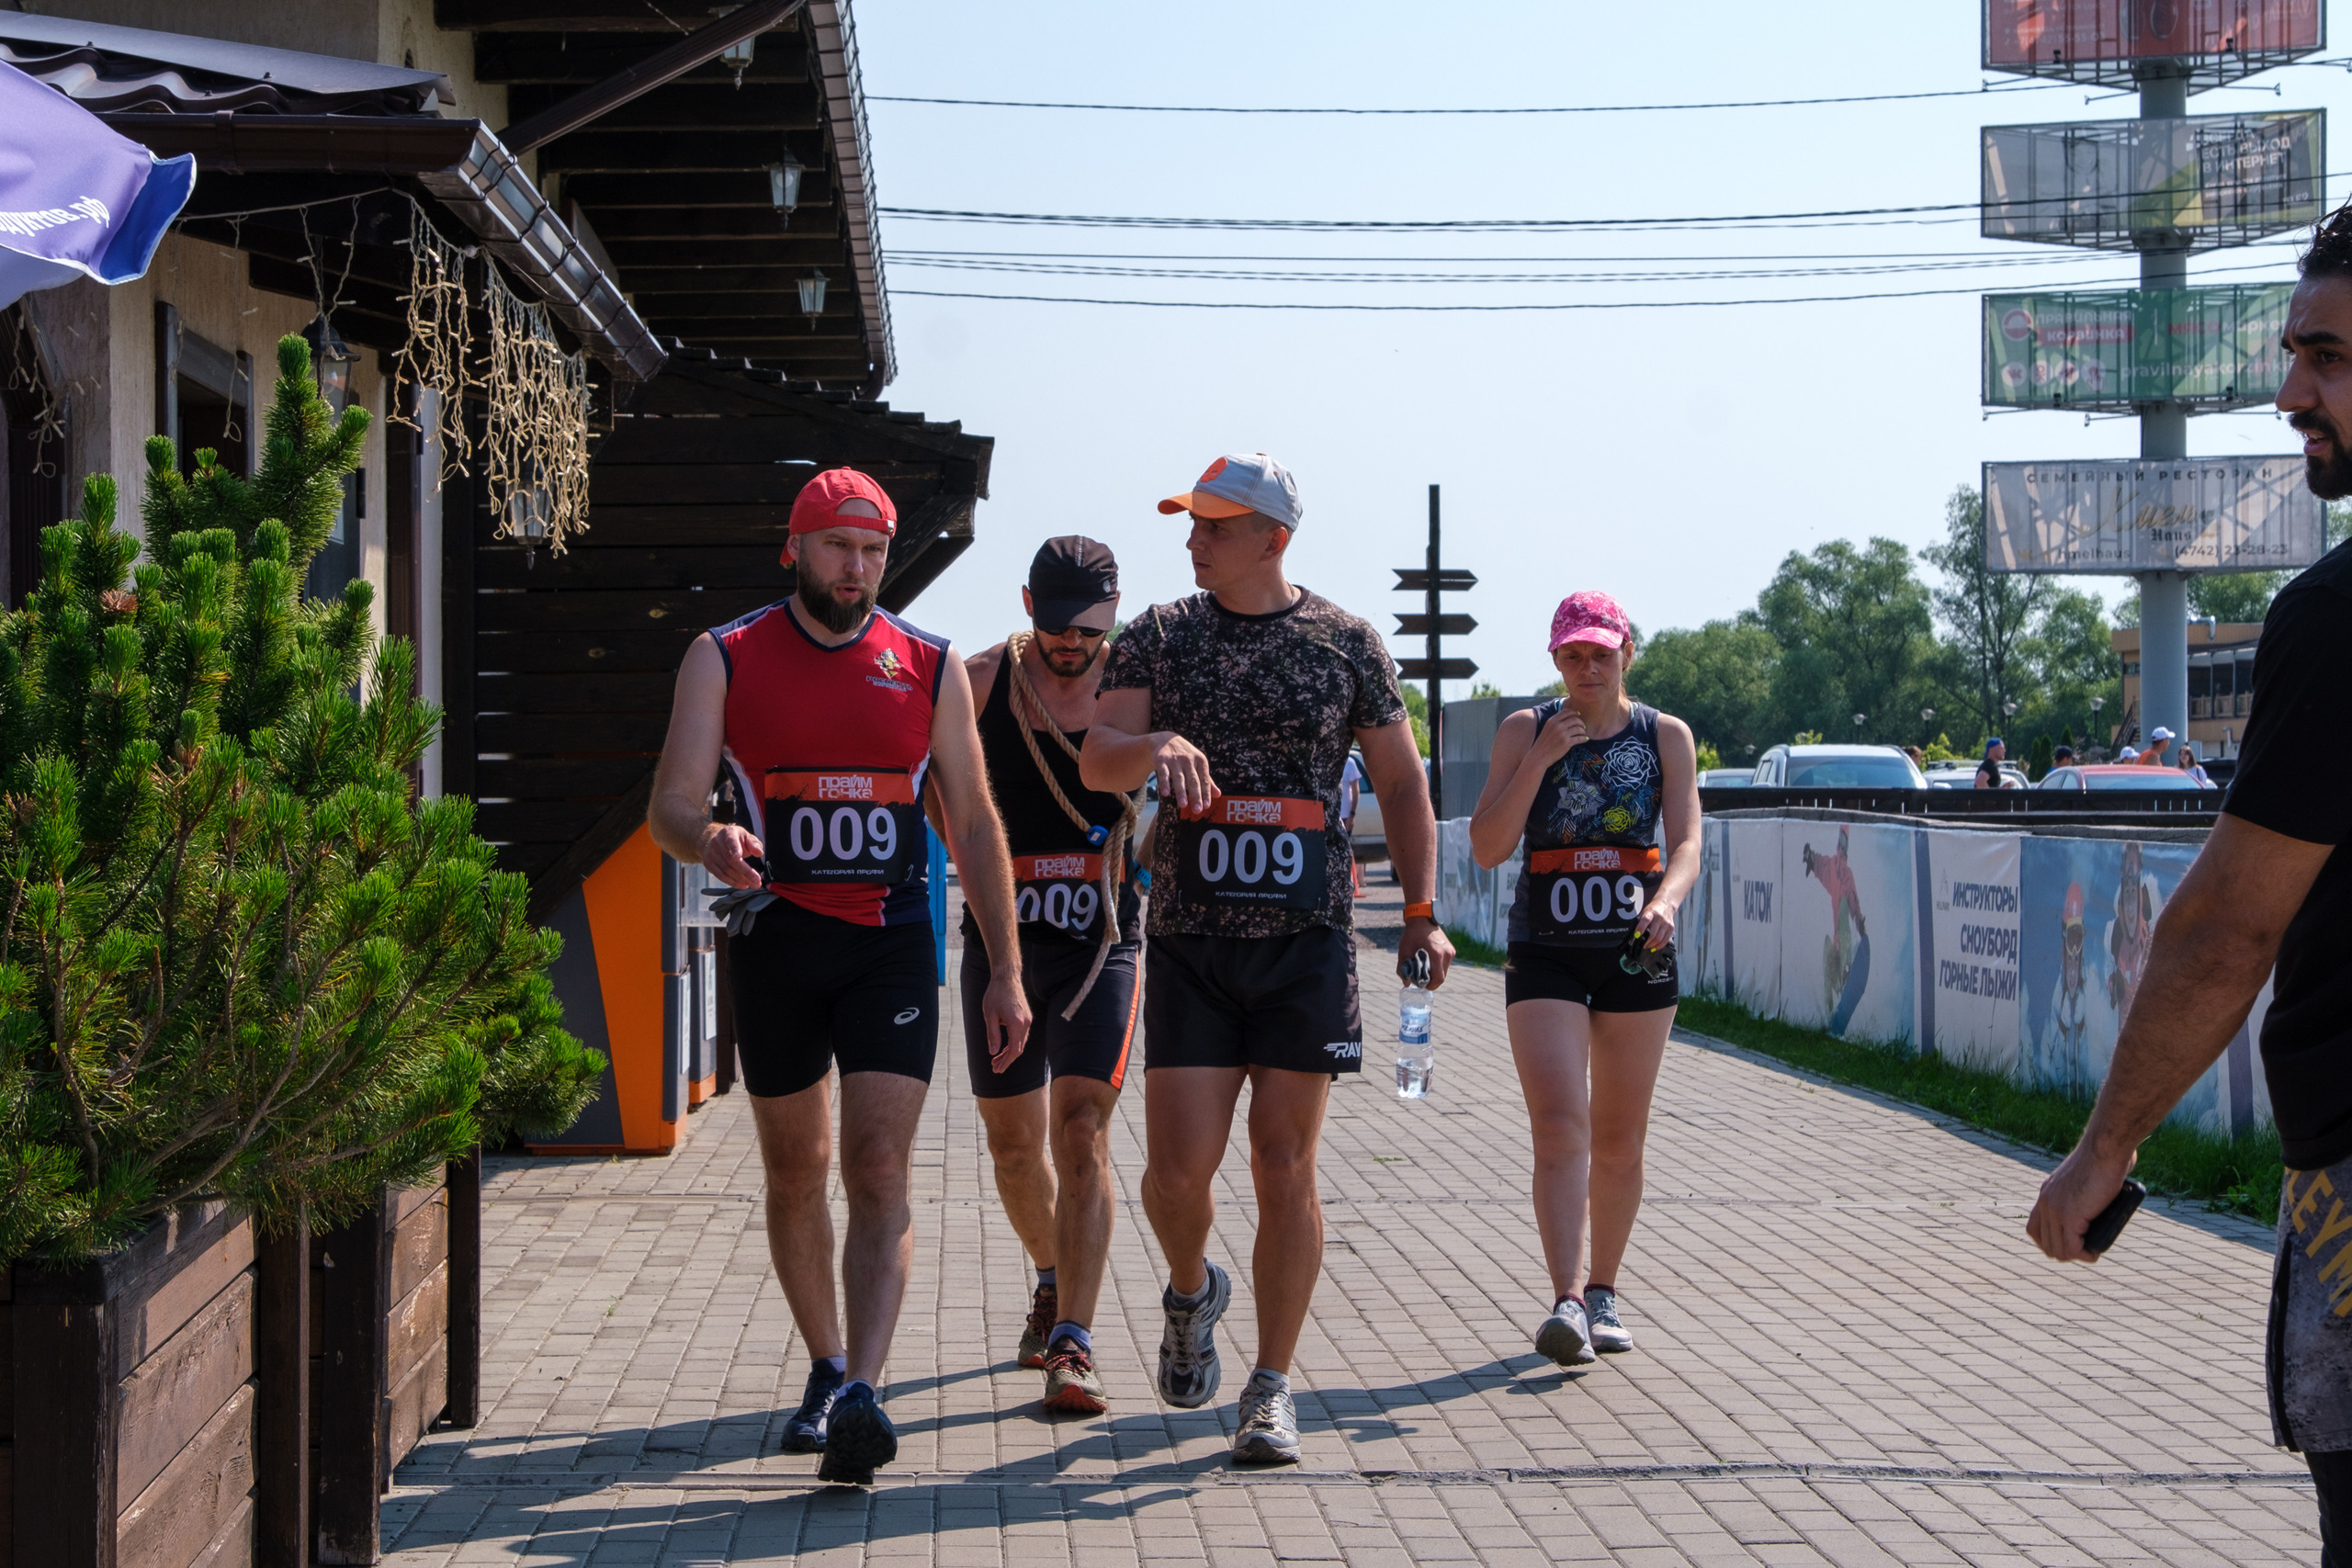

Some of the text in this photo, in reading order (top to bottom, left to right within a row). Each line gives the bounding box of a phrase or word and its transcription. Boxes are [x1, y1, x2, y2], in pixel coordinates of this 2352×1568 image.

[2215, 152, 2284, 172] ИНТЕРНЕТ
[2240, 136, 2291, 152] ВЫХОД
[2027, 468, 2272, 484] СЕМЕЙНЫЙ РЕСТОРАН
[790, 807, 897, 861] 009
[1199, 829, 1304, 885] 009
[1550, 874, 1645, 923] 009
[1744, 880, 1773, 923] КАТОК
[1952, 882, 2018, 913] ИНСТРУКТОРЫ
[1961, 923, 2018, 964] СНОУБОРД
[1939, 959, 2018, 1001] ГОРНЫЕ ЛЫЖИ
